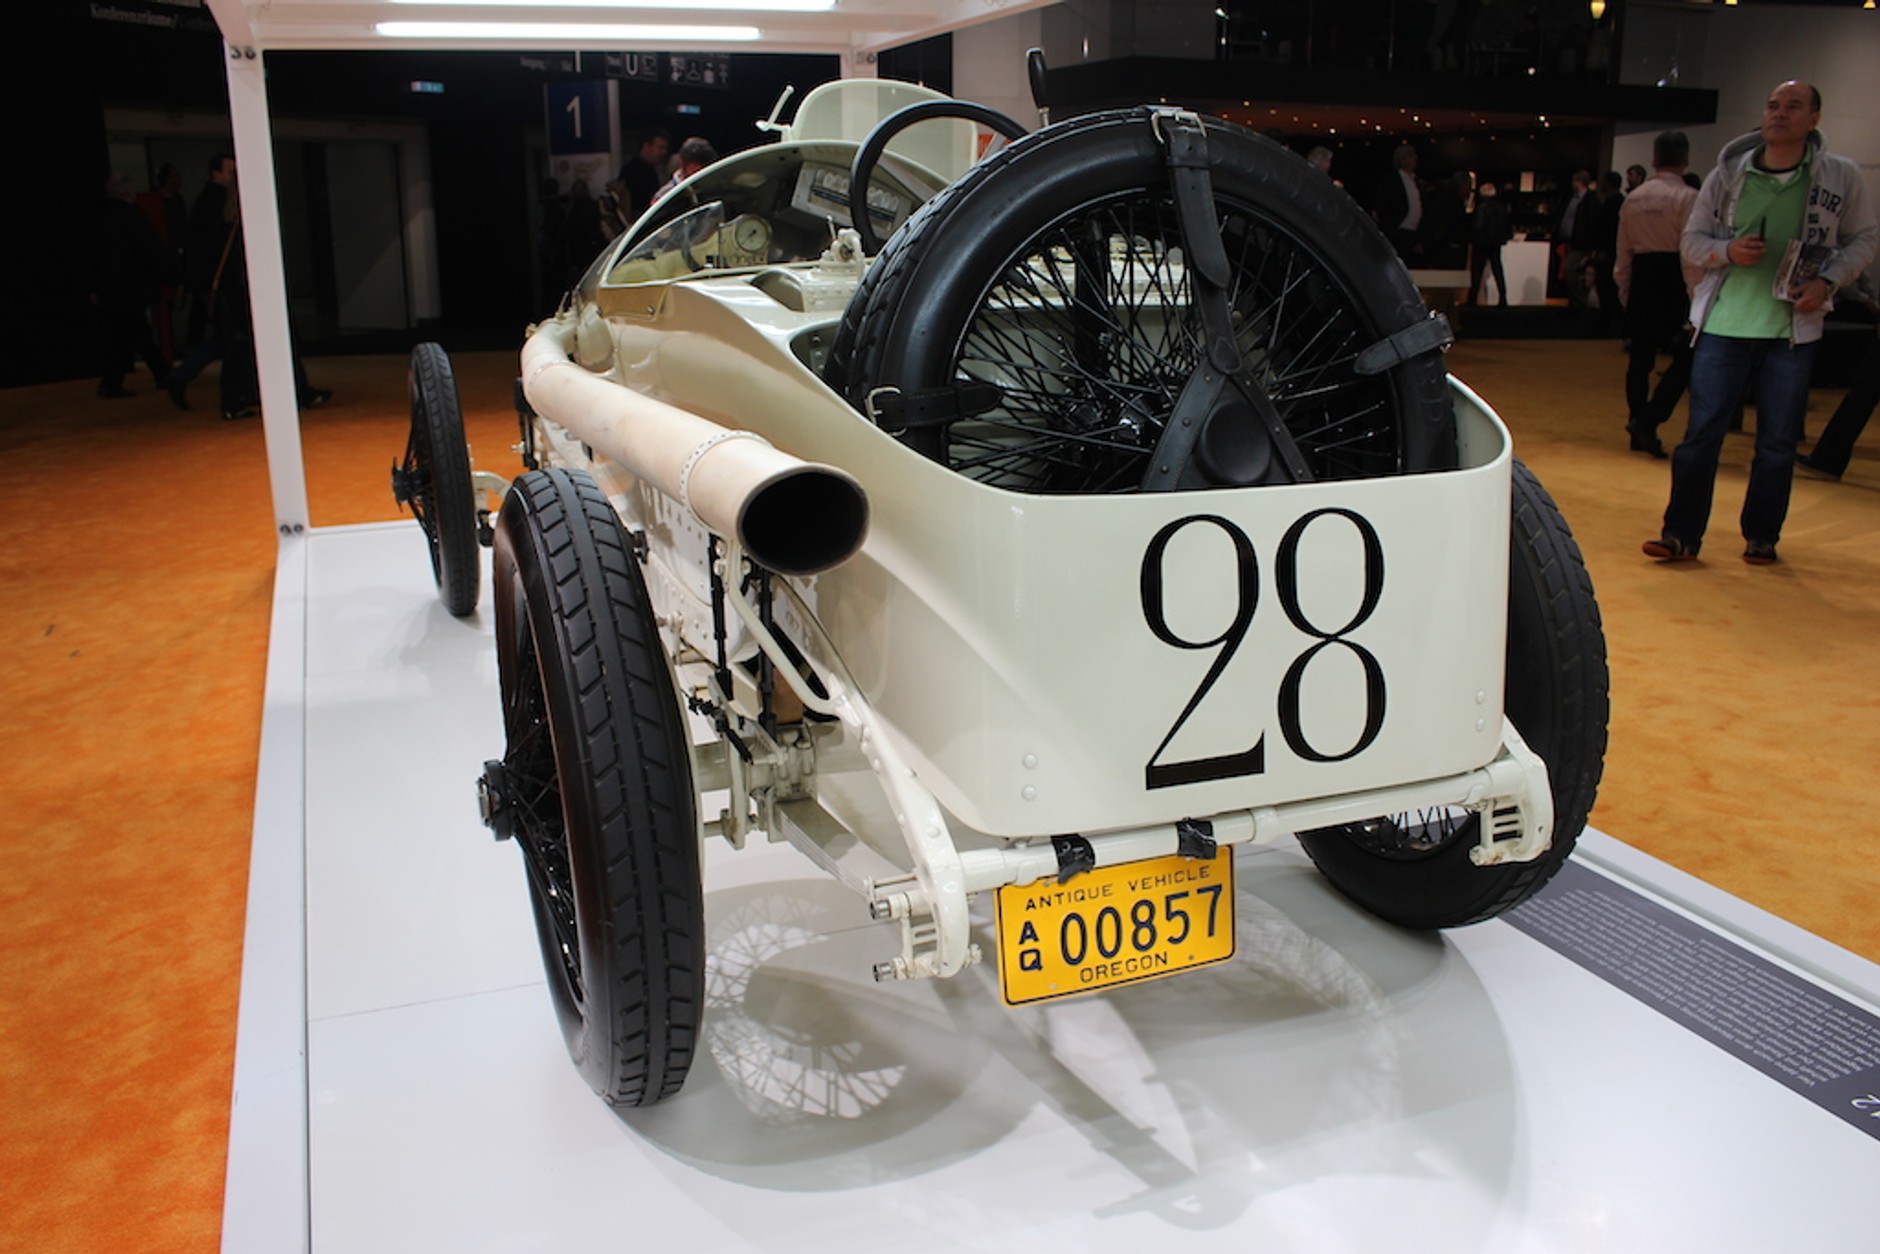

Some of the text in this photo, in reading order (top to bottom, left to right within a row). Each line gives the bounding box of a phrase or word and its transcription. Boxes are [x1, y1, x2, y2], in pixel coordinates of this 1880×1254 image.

[566, 96, 582, 138] 1
[1140, 507, 1387, 790] 28
[1024, 865, 1211, 911] ANTIQUE VEHICLE
[1060, 883, 1223, 966] 00857
[1080, 952, 1168, 983] OREGON
